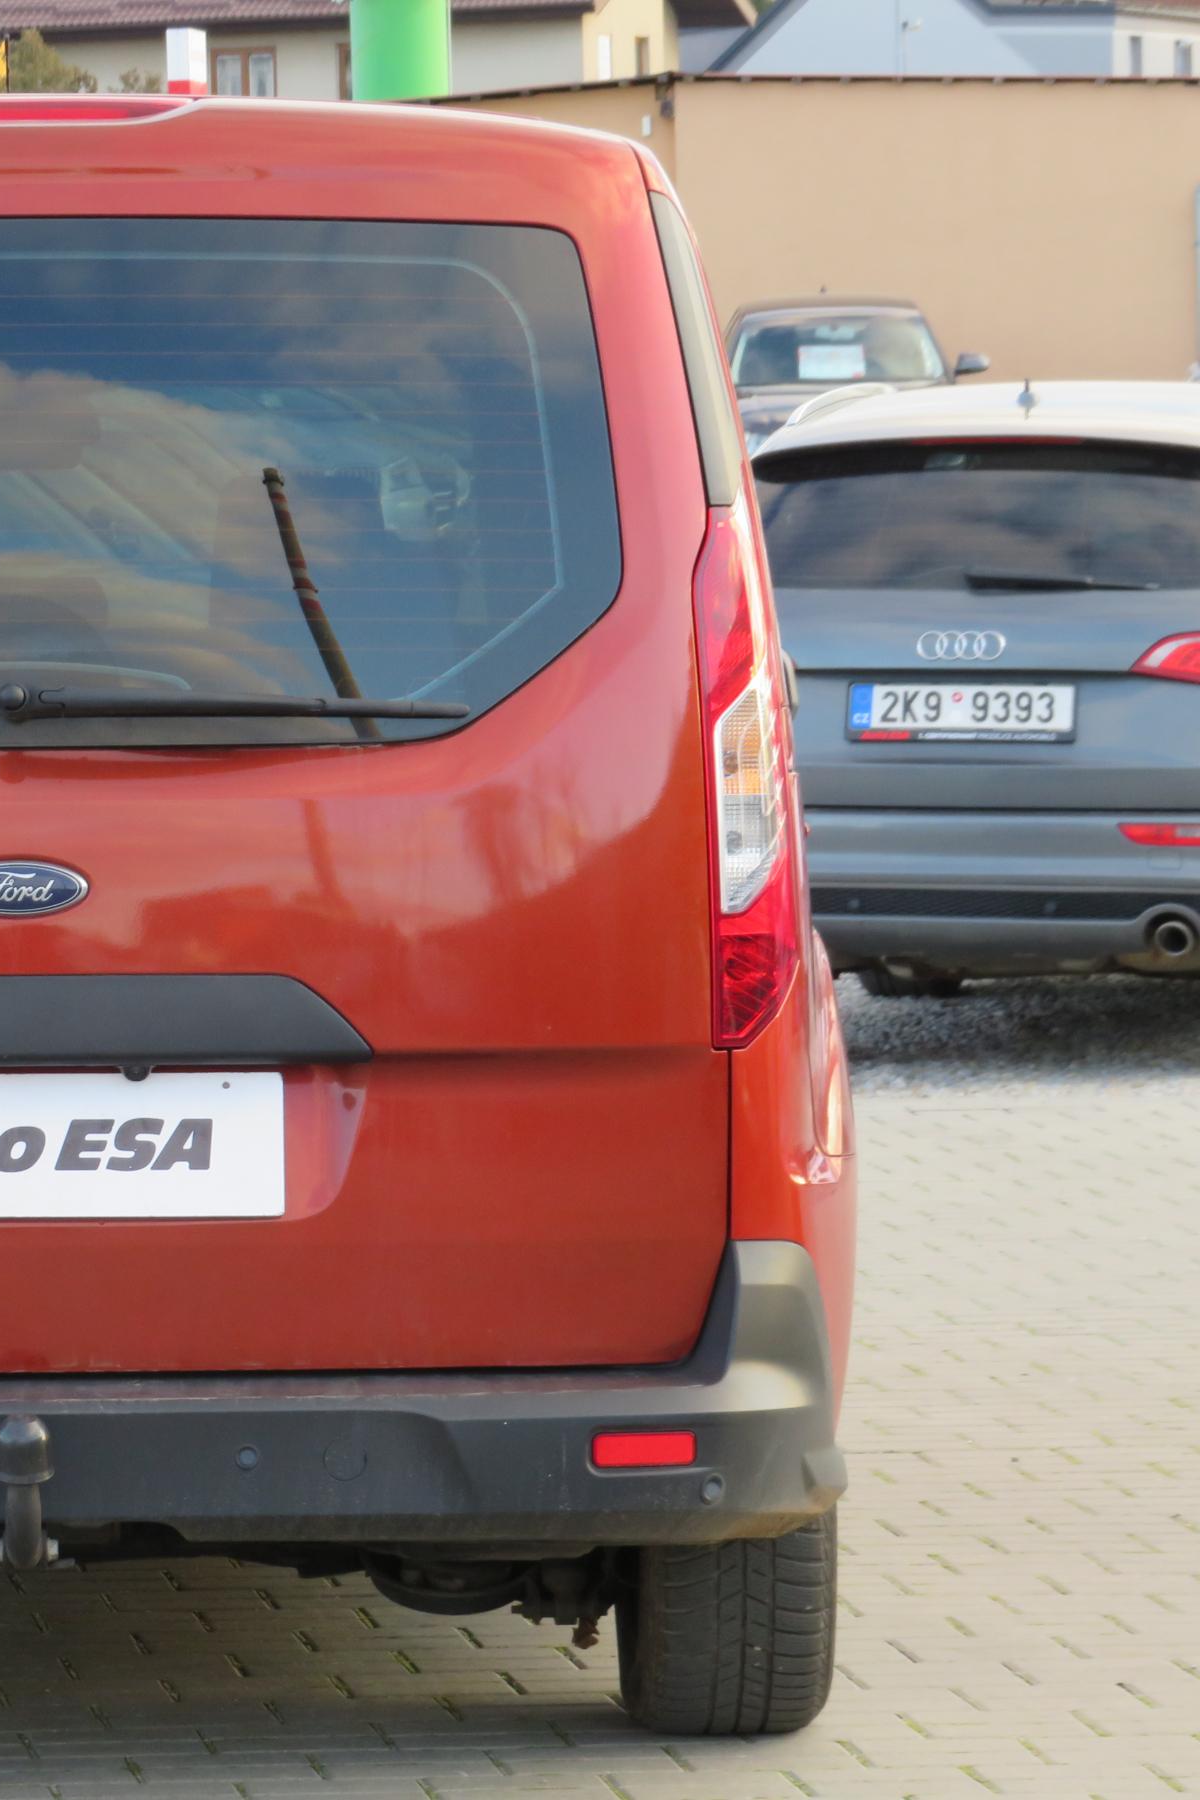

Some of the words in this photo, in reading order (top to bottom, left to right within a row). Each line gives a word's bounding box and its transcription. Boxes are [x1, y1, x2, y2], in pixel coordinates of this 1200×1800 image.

[853, 713, 870, 724] CZ
[880, 690, 943, 723] 2K9
[971, 690, 1055, 723] 9393
[54, 1118, 214, 1172] ESA
